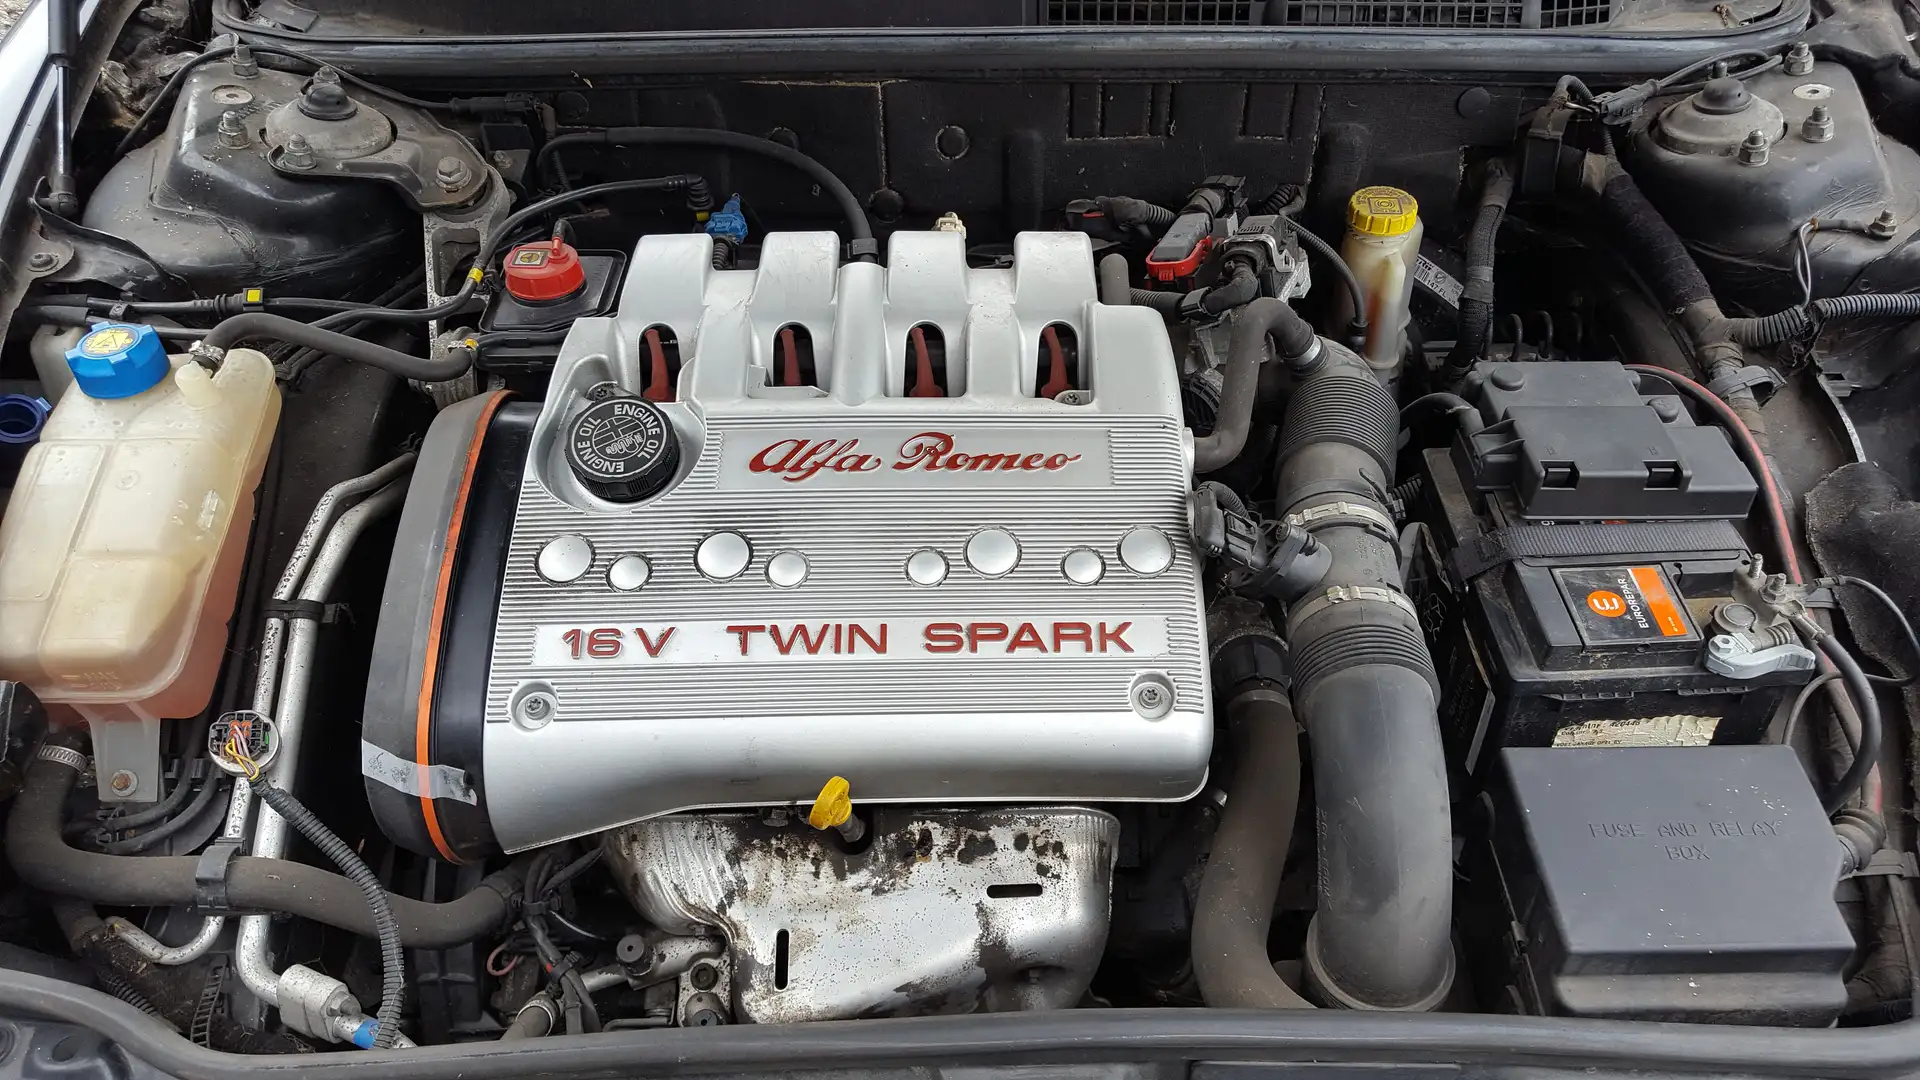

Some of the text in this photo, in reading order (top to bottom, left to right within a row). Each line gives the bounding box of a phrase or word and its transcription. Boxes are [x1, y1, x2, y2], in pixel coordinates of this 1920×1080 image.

[577, 416, 624, 473] ENGINE OIL
[614, 404, 660, 459] ENGINE OIL
[748, 431, 1083, 484] Alfa Romeo
[1617, 577, 1650, 629] EUROREPAR
[726, 622, 888, 657] TWIN
[924, 621, 1135, 654] SPARK
[1588, 820, 1779, 838] FUSE AND RELAY
[1664, 844, 1711, 861] BOX
